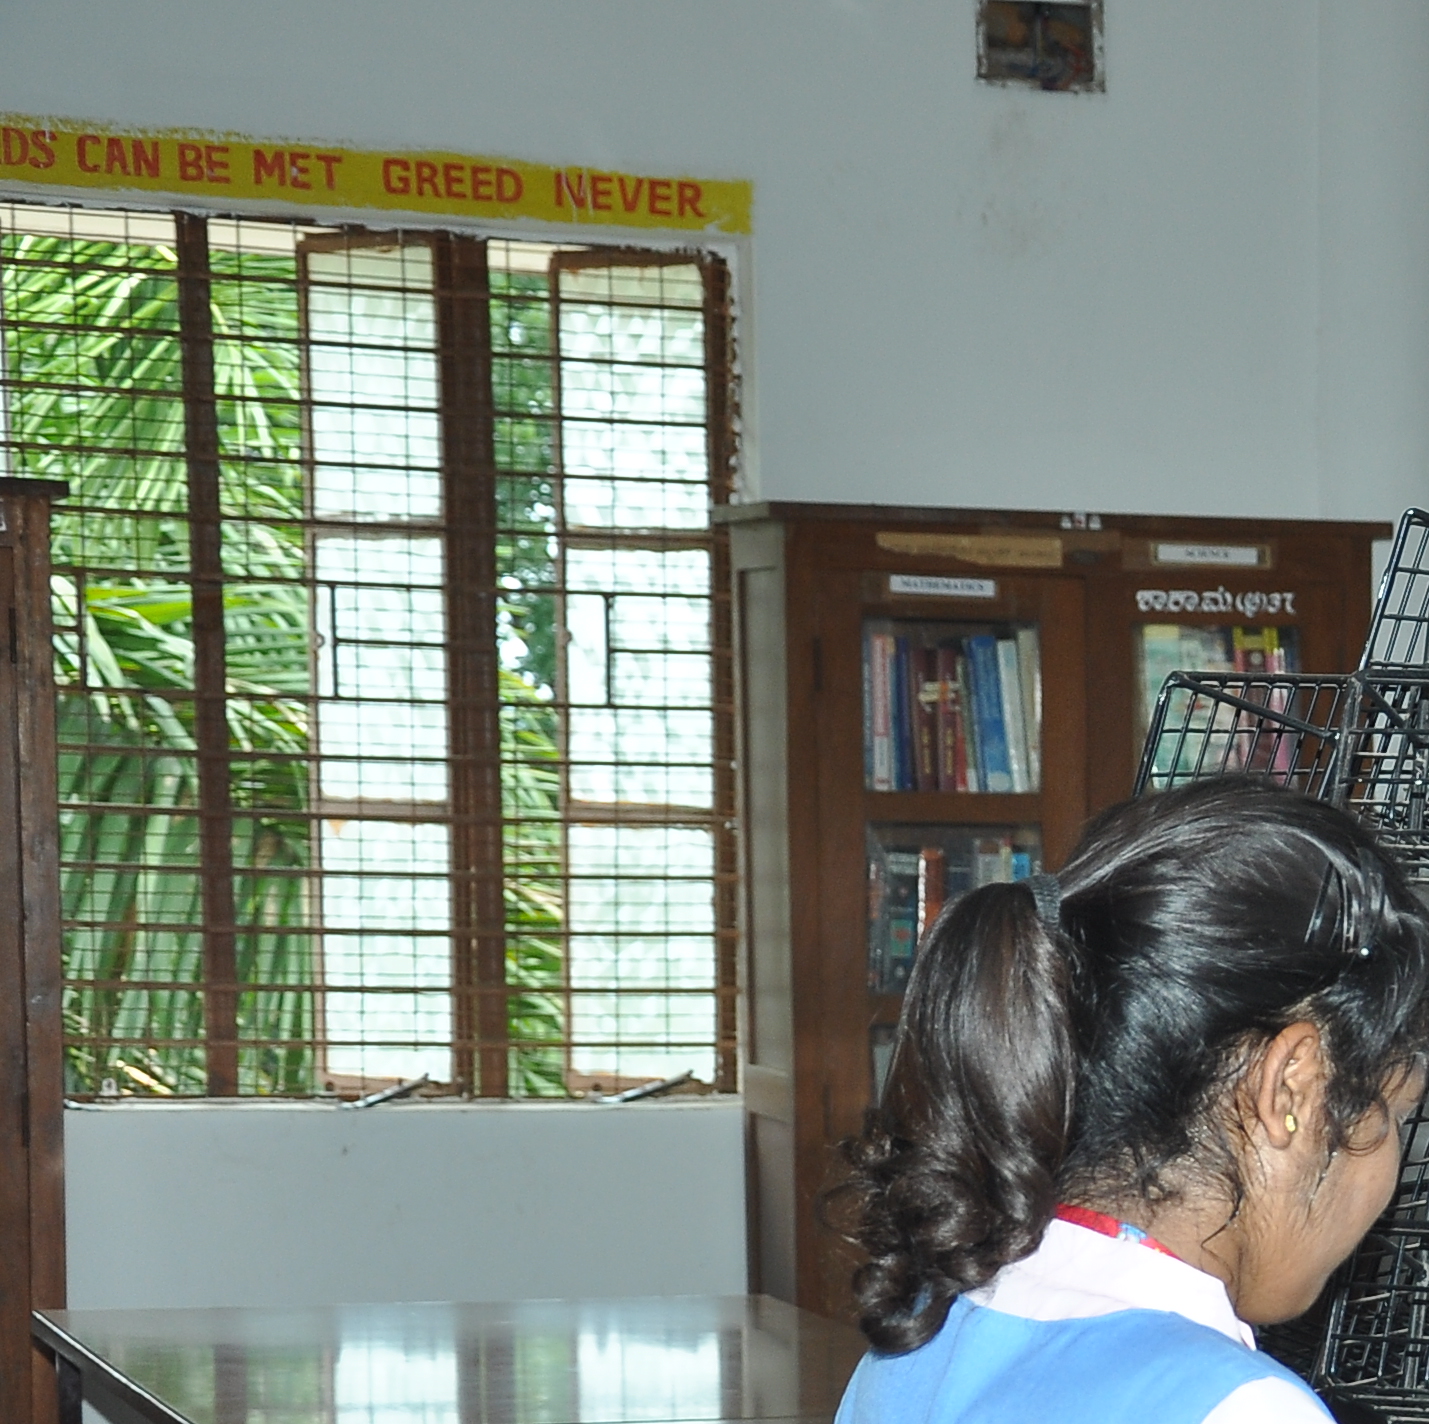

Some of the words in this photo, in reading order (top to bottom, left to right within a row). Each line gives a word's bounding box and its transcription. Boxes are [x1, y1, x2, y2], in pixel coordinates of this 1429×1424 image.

[76, 133, 162, 178] CAN
[179, 143, 231, 184] BE
[253, 148, 343, 191] MET
[382, 157, 525, 205] GREED
[553, 171, 708, 219] NEVER
